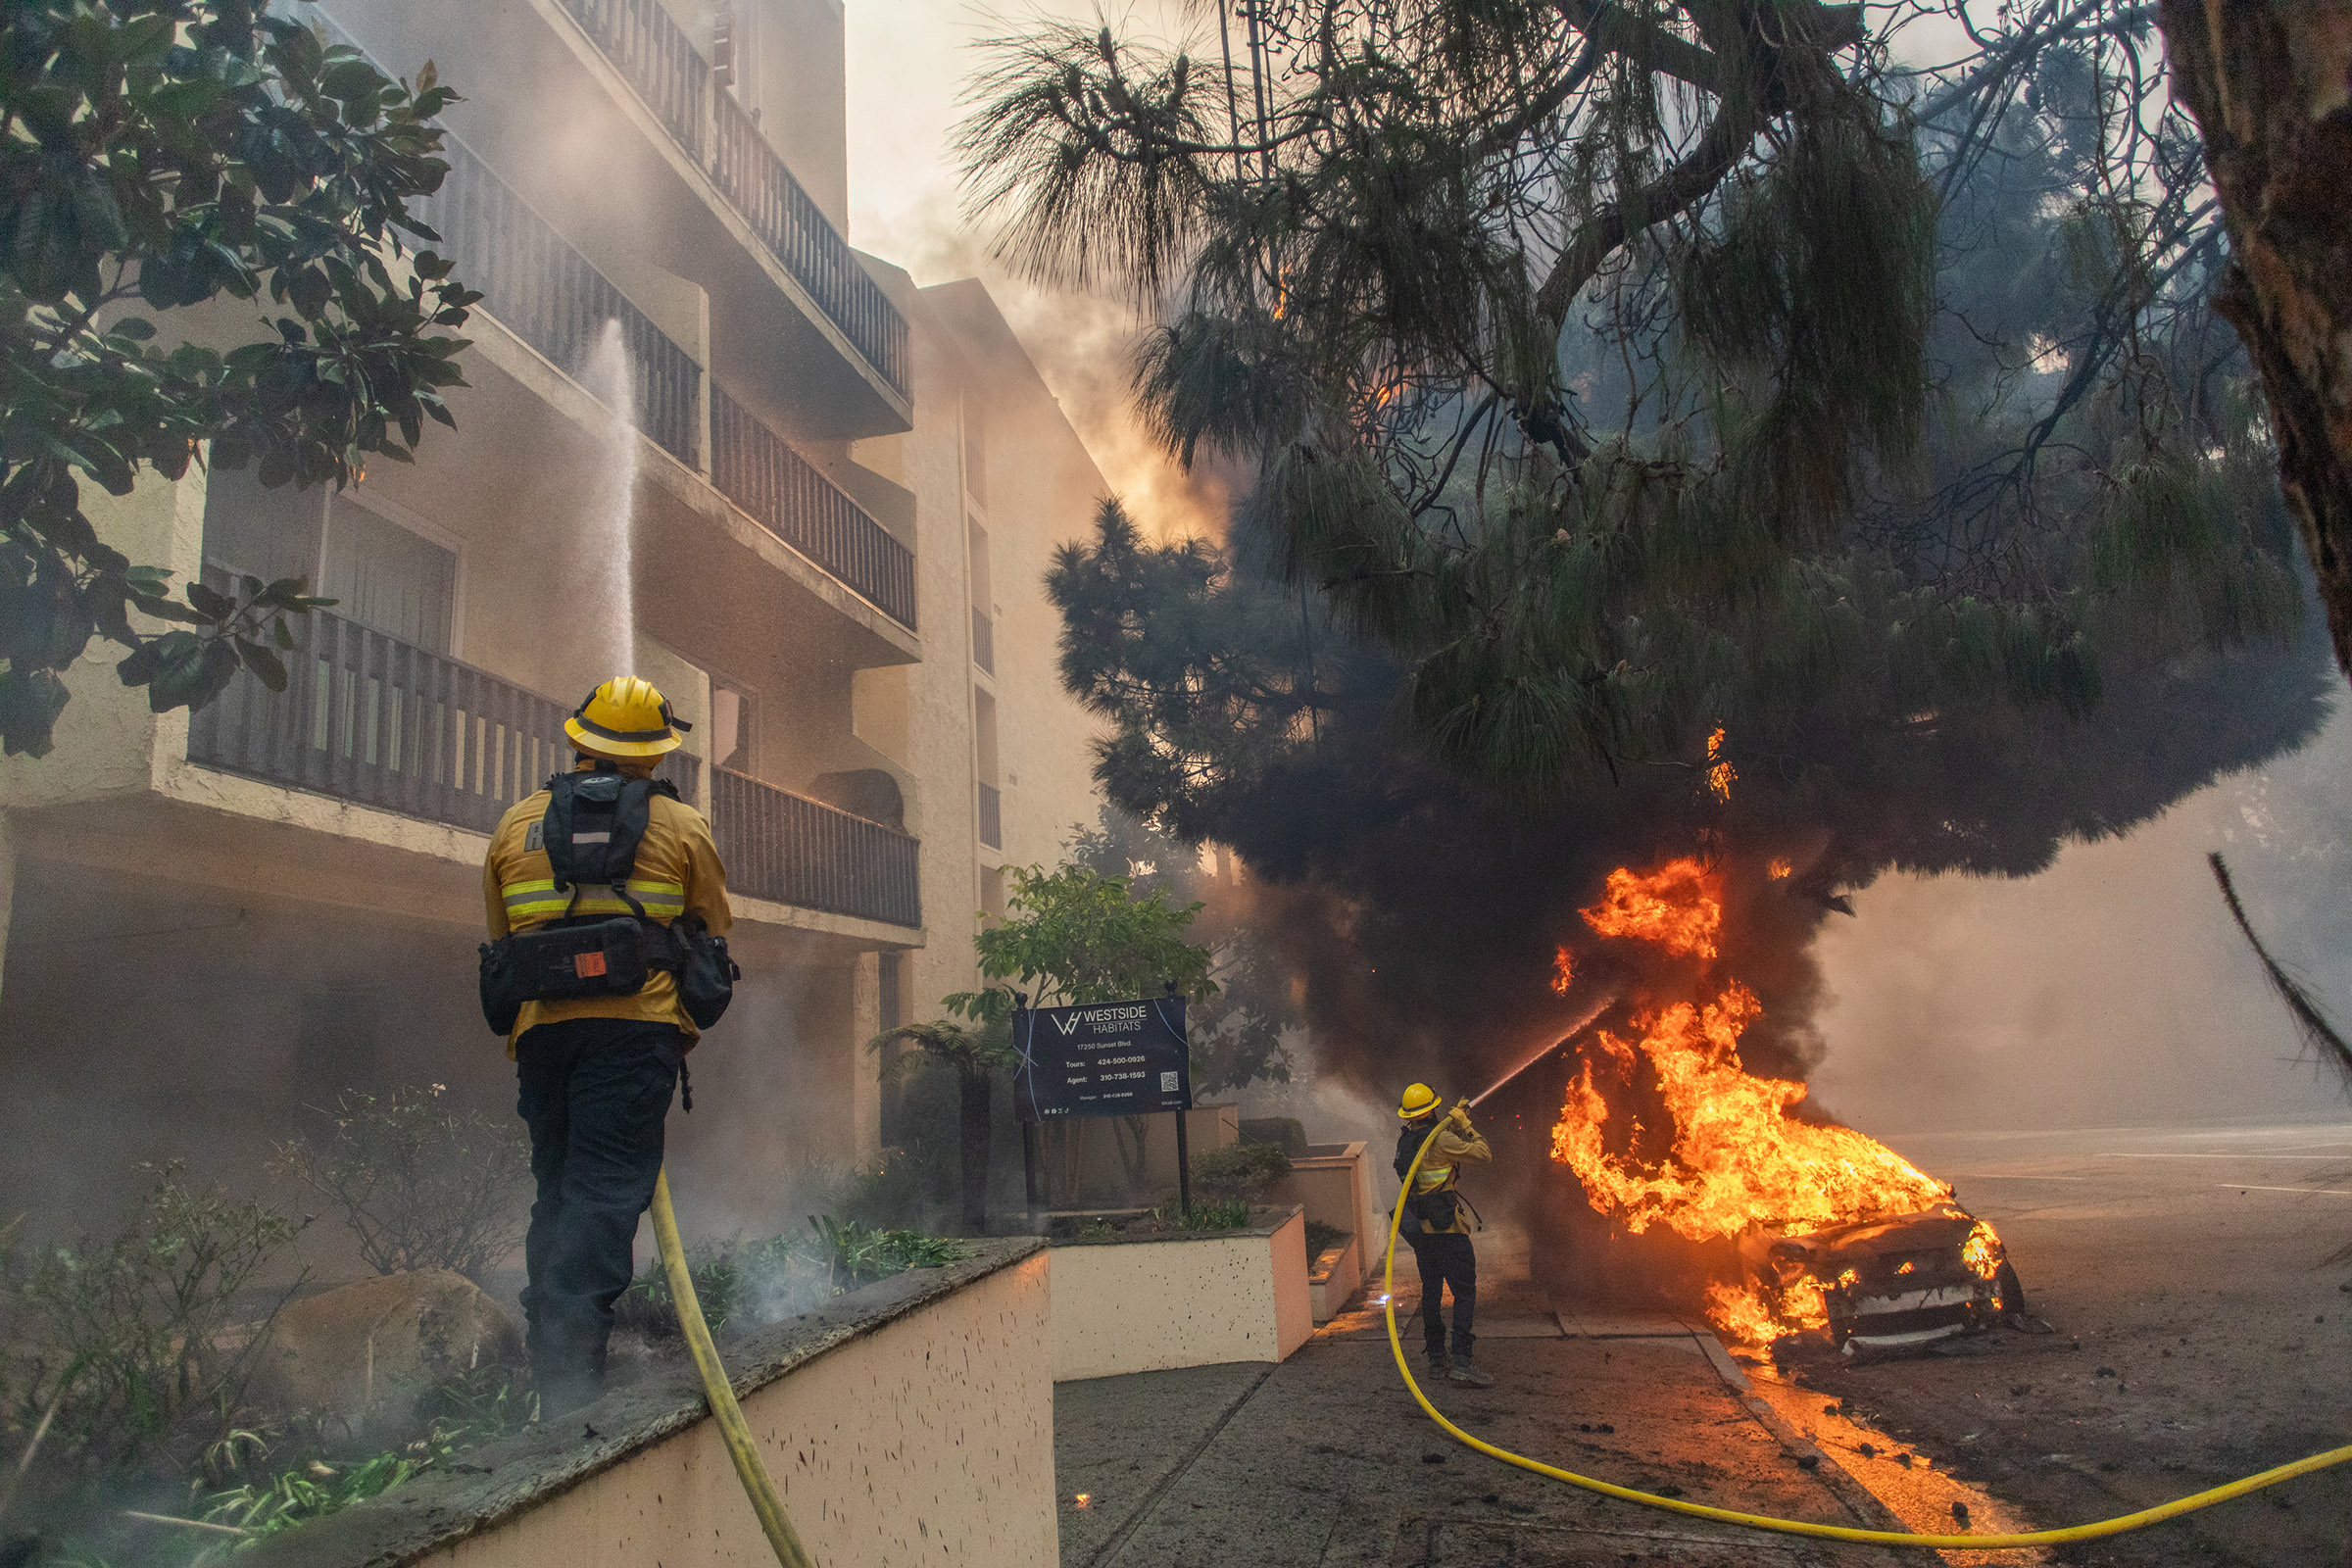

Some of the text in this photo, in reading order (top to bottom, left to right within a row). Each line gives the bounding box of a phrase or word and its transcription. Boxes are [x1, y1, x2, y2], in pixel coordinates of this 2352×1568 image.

[1083, 1005, 1147, 1022] WESTSIDE
[1093, 1021, 1142, 1034] HABITATS
[1098, 1054, 1146, 1065] 424-500-0926
[1066, 1071, 1146, 1085] Agent: 310-738-1593
